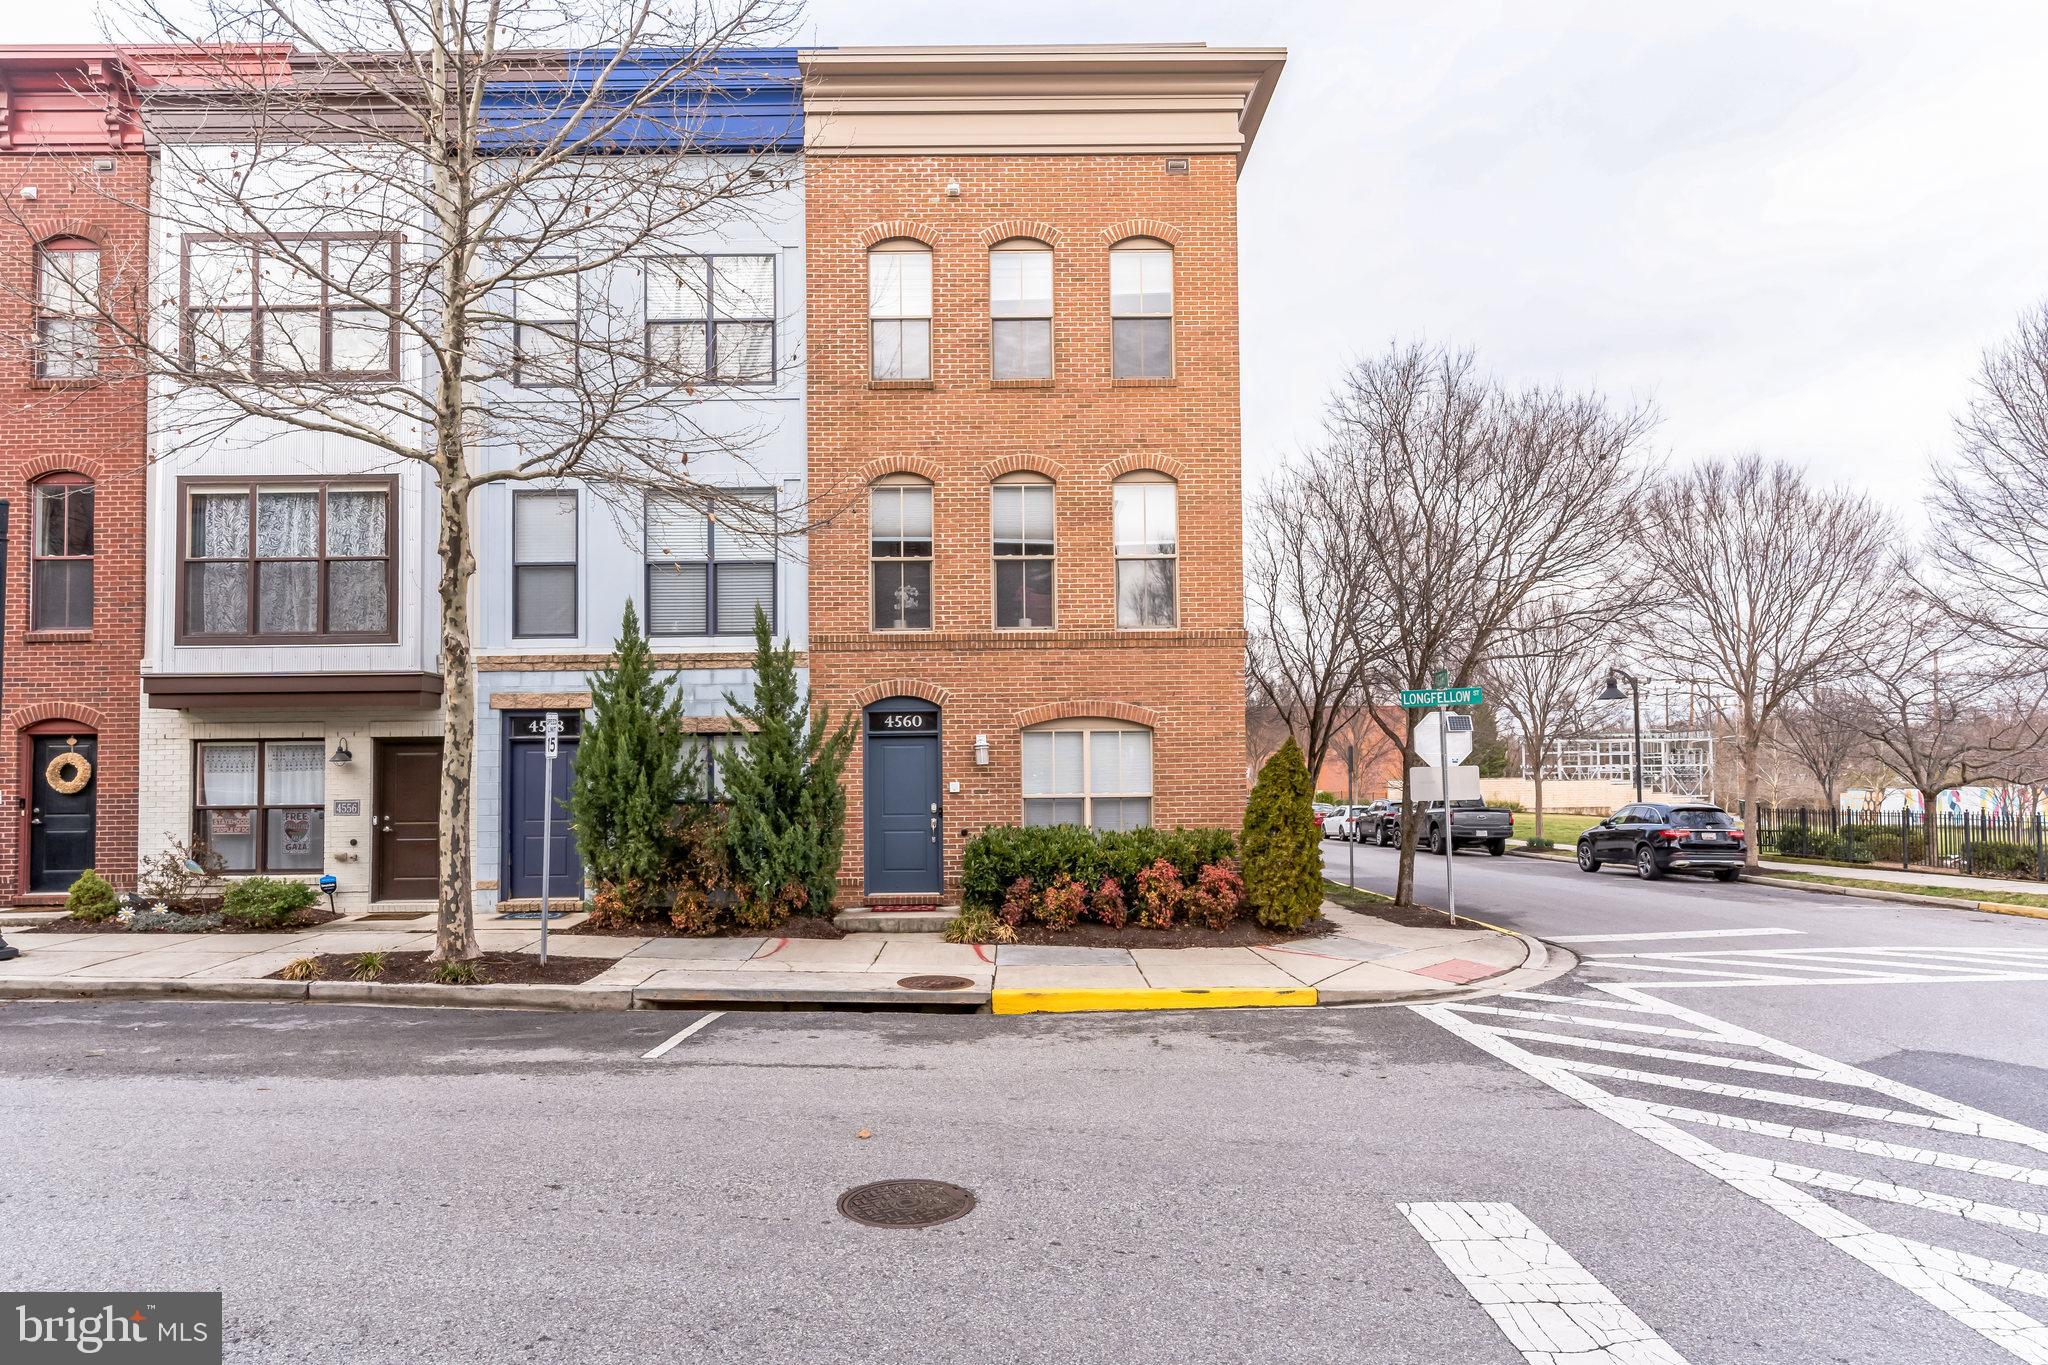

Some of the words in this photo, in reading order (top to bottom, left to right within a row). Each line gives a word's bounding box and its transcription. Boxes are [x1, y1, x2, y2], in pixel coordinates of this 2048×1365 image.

[1403, 690, 1471, 705] LONGFELLOW
[528, 720, 565, 733] 458
[884, 715, 923, 728] 4560
[547, 737, 556, 753] 15
[336, 803, 357, 813] 4556
[285, 812, 308, 821] FREE
[285, 843, 308, 851] GAZA
